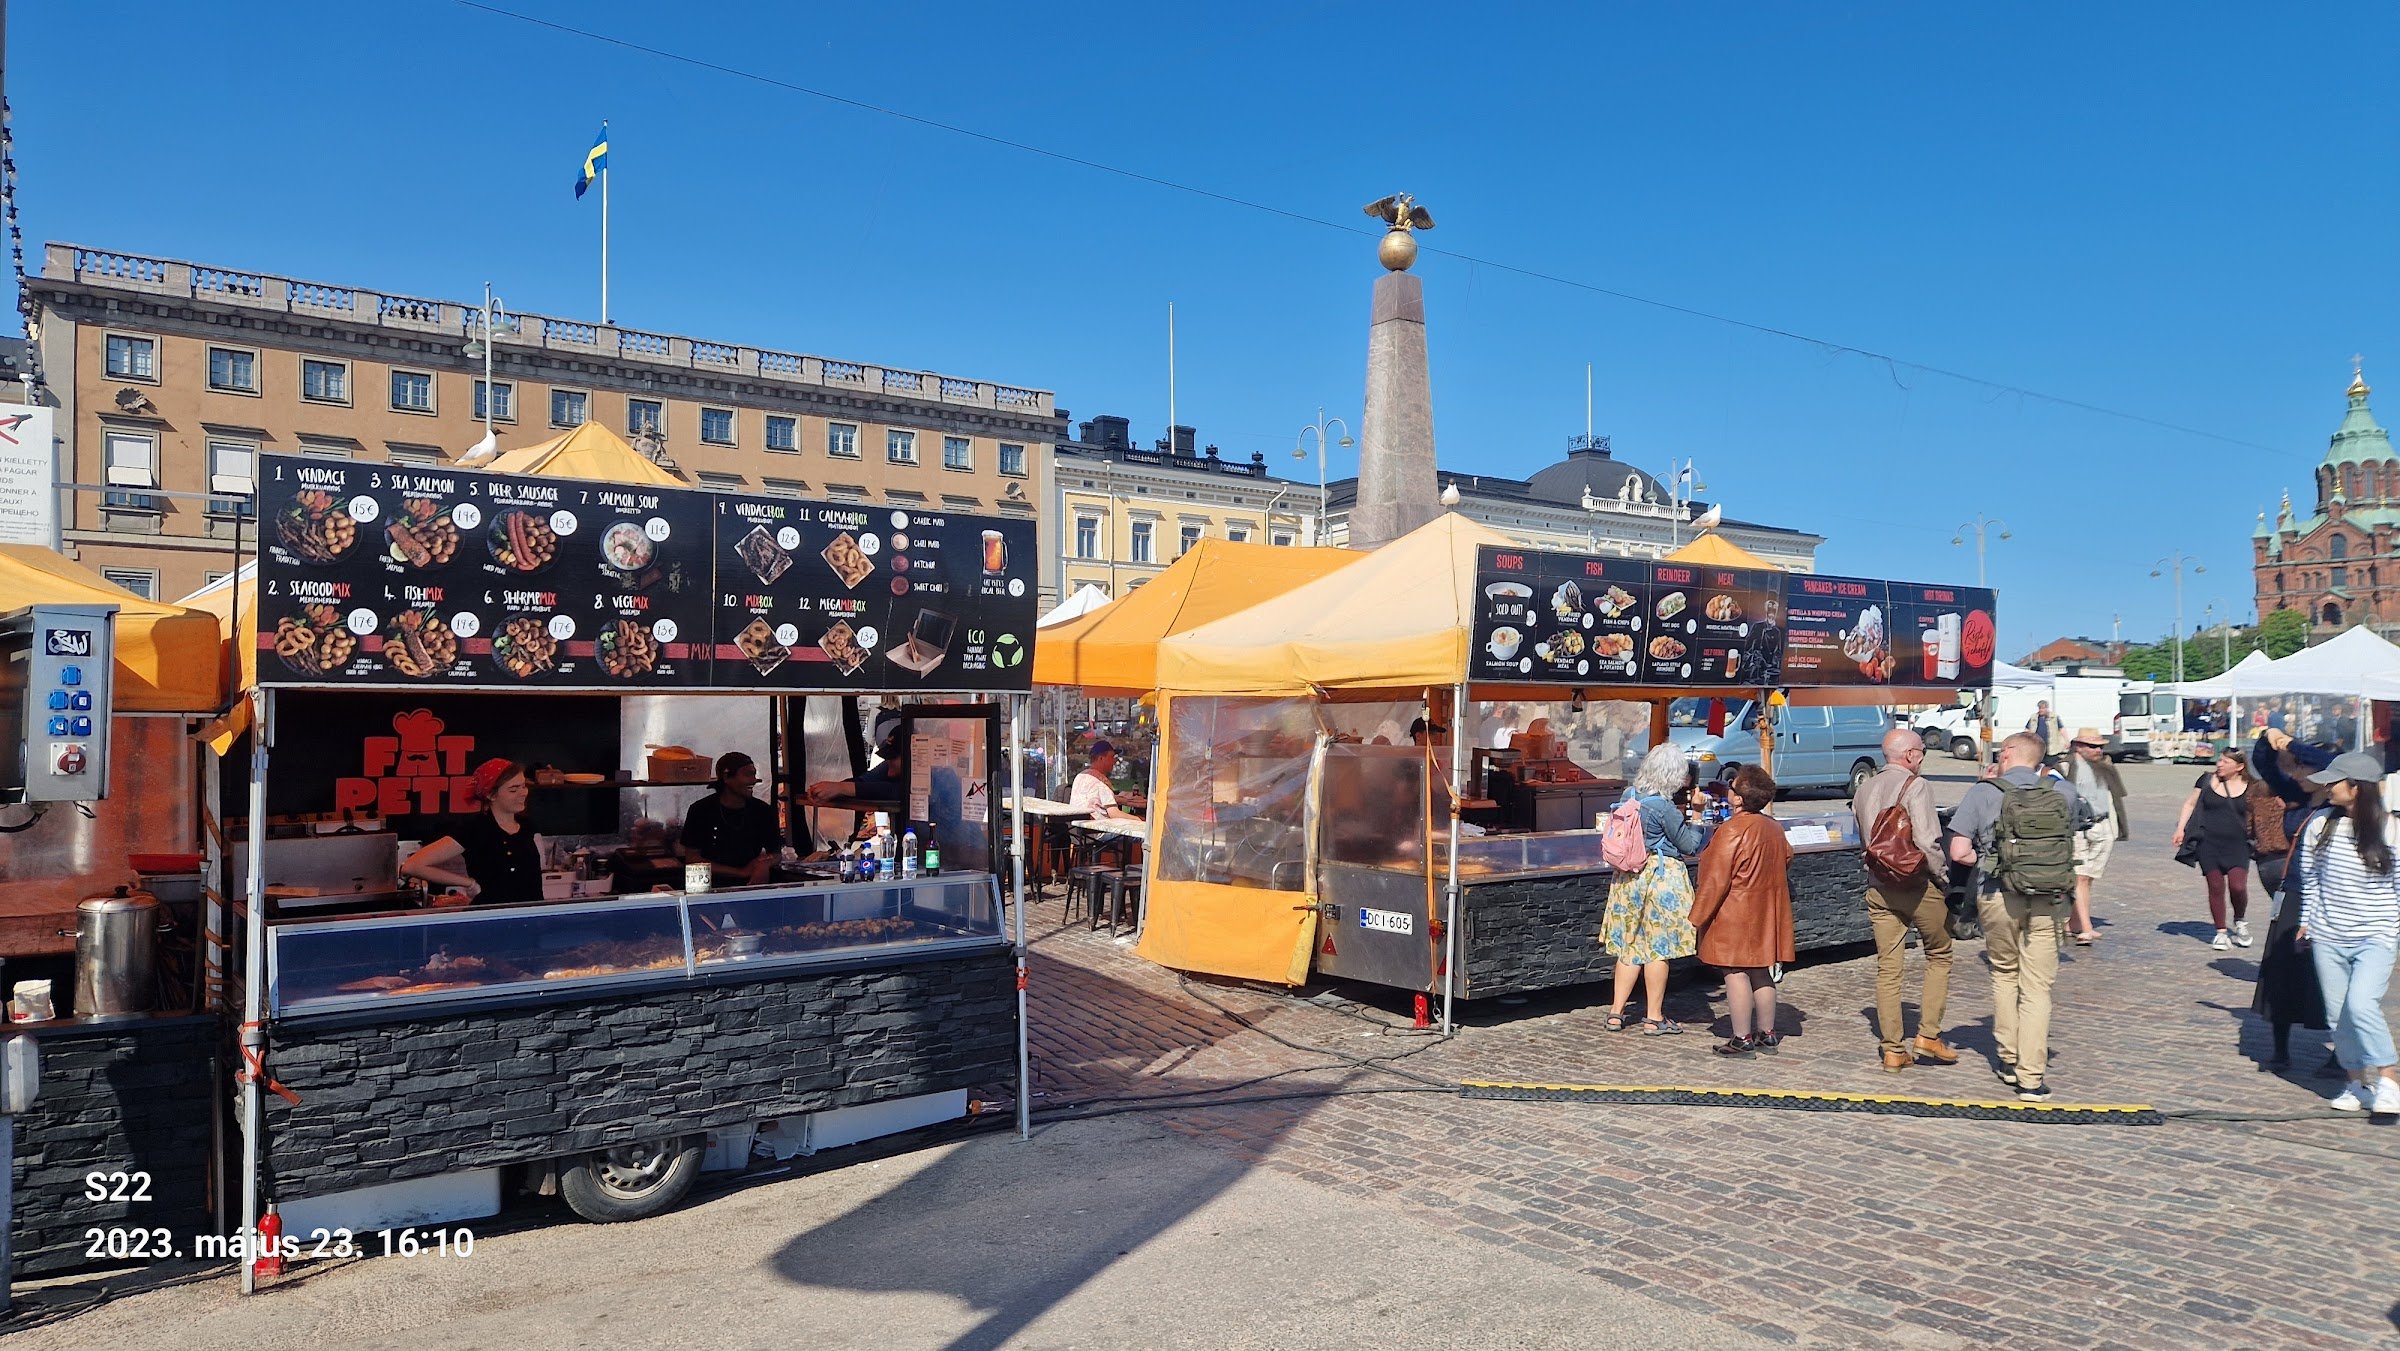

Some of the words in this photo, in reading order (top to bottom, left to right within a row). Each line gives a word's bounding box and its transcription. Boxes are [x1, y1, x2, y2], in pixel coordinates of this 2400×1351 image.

[4, 456, 48, 466] KIELLETTY
[297, 467, 346, 485] VENDACE
[370, 472, 383, 489] 3.
[391, 474, 410, 490] SEA
[414, 476, 455, 494] SALMON
[469, 481, 480, 496] 5.
[488, 482, 513, 499] DEER
[517, 485, 559, 502] SAUSAGE
[579, 490, 590, 505] 7.
[598, 491, 635, 508] SALMON
[638, 494, 659, 510] SOUP
[718, 501, 727, 515] 9.
[735, 502, 785, 519] VENDACEBOX
[1496, 554, 1524, 570] SOUPS
[1585, 561, 1603, 576] FISH
[1657, 567, 1691, 583] REINDEER
[1717, 572, 1735, 586] MEAT
[267, 579, 280, 596] 2.
[289, 580, 351, 598] SEAFOODMIX
[384, 584, 397, 601] 4.
[404, 585, 444, 601] FISHMIX
[1804, 579, 1833, 594] PANCAKES
[1847, 583, 1867, 596] CREAM
[612, 595, 649, 610] VEGEMIX
[723, 593, 738, 608] 10.
[745, 594, 774, 609] MIXBOX
[798, 596, 812, 611] 12.
[819, 598, 867, 613] MEGAMIXBOX
[1495, 603, 1509, 616] SOLD
[1510, 603, 1524, 616] OUT!
[353, 616, 373, 628] 17€
[553, 621, 571, 633] 17€
[967, 628, 985, 645] ECO
[690, 643, 711, 660] MIX
[364, 722, 475, 777] FAT
[686, 873, 710, 884] TIPS
